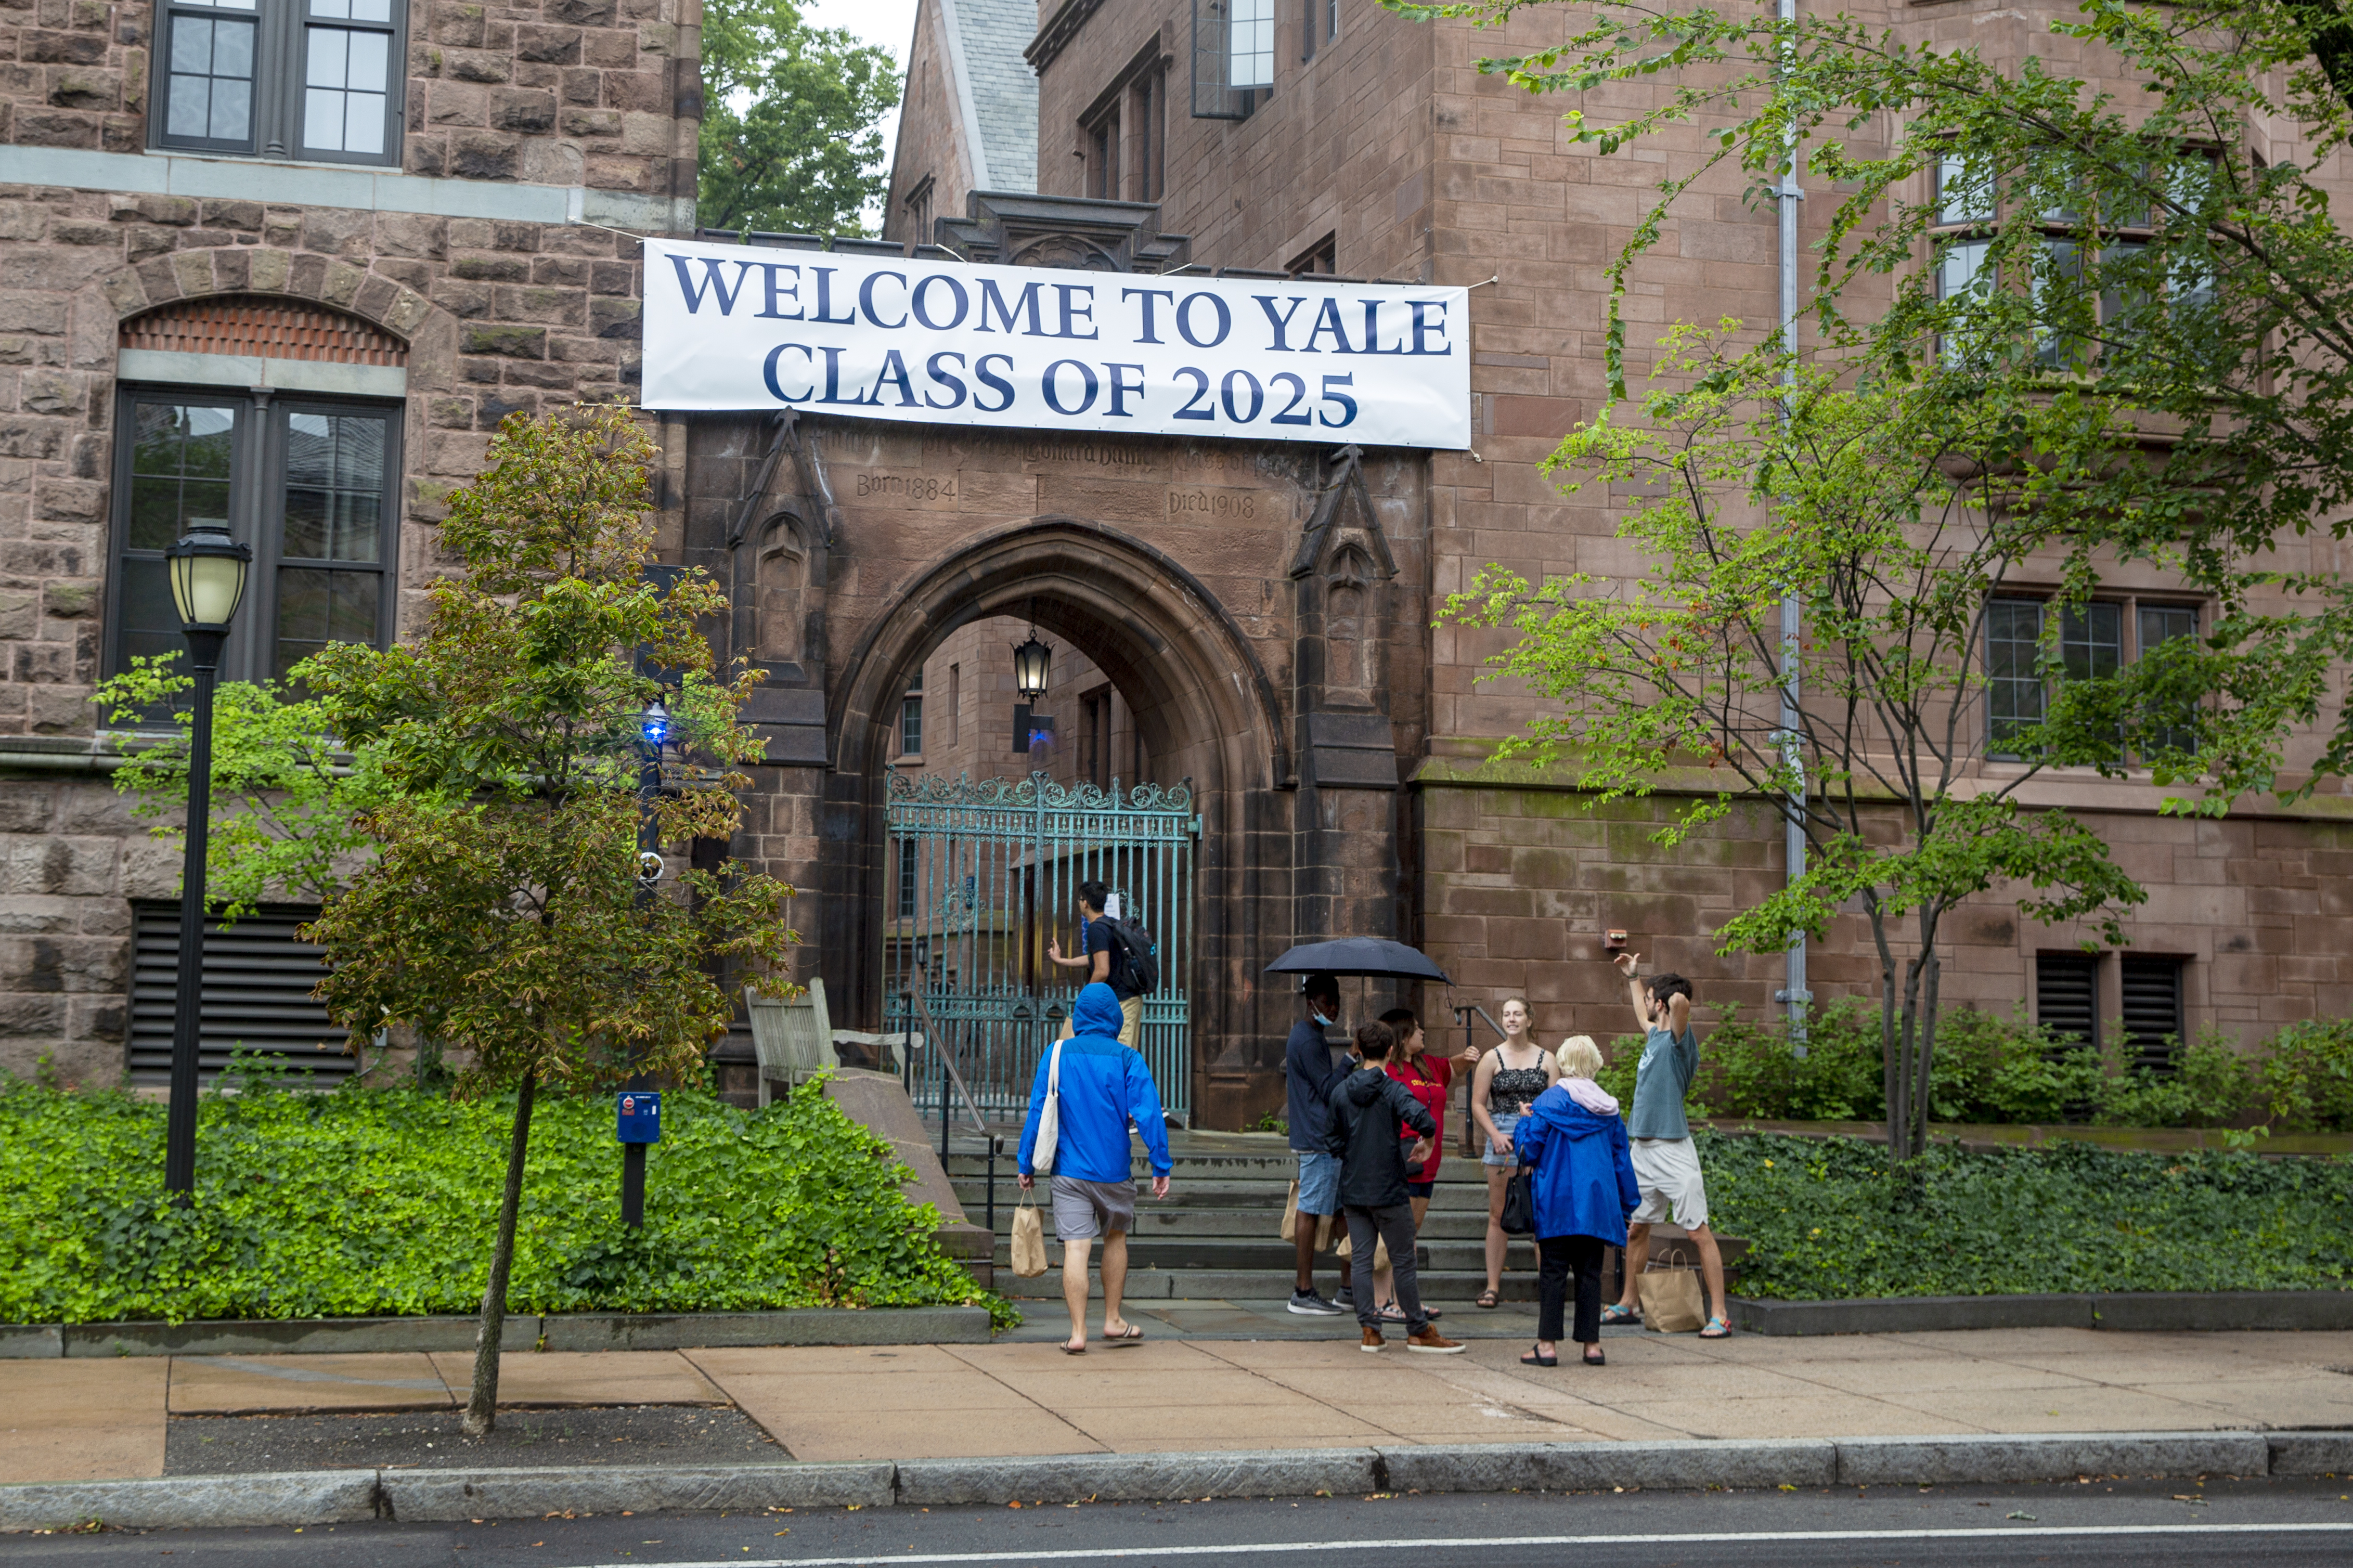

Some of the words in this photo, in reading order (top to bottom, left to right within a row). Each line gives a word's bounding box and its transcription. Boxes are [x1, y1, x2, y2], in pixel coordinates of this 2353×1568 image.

[665, 254, 1098, 340] WELCOME
[1122, 288, 1231, 347] TO
[1251, 296, 1451, 356] YALE
[764, 344, 1015, 412] CLASS
[1042, 360, 1145, 417] OF
[1173, 367, 1358, 429] 2025
[857, 474, 903, 497] Born
[905, 477, 956, 502] 1884
[1169, 490, 1209, 515] Died
[1211, 495, 1255, 519] 1908
